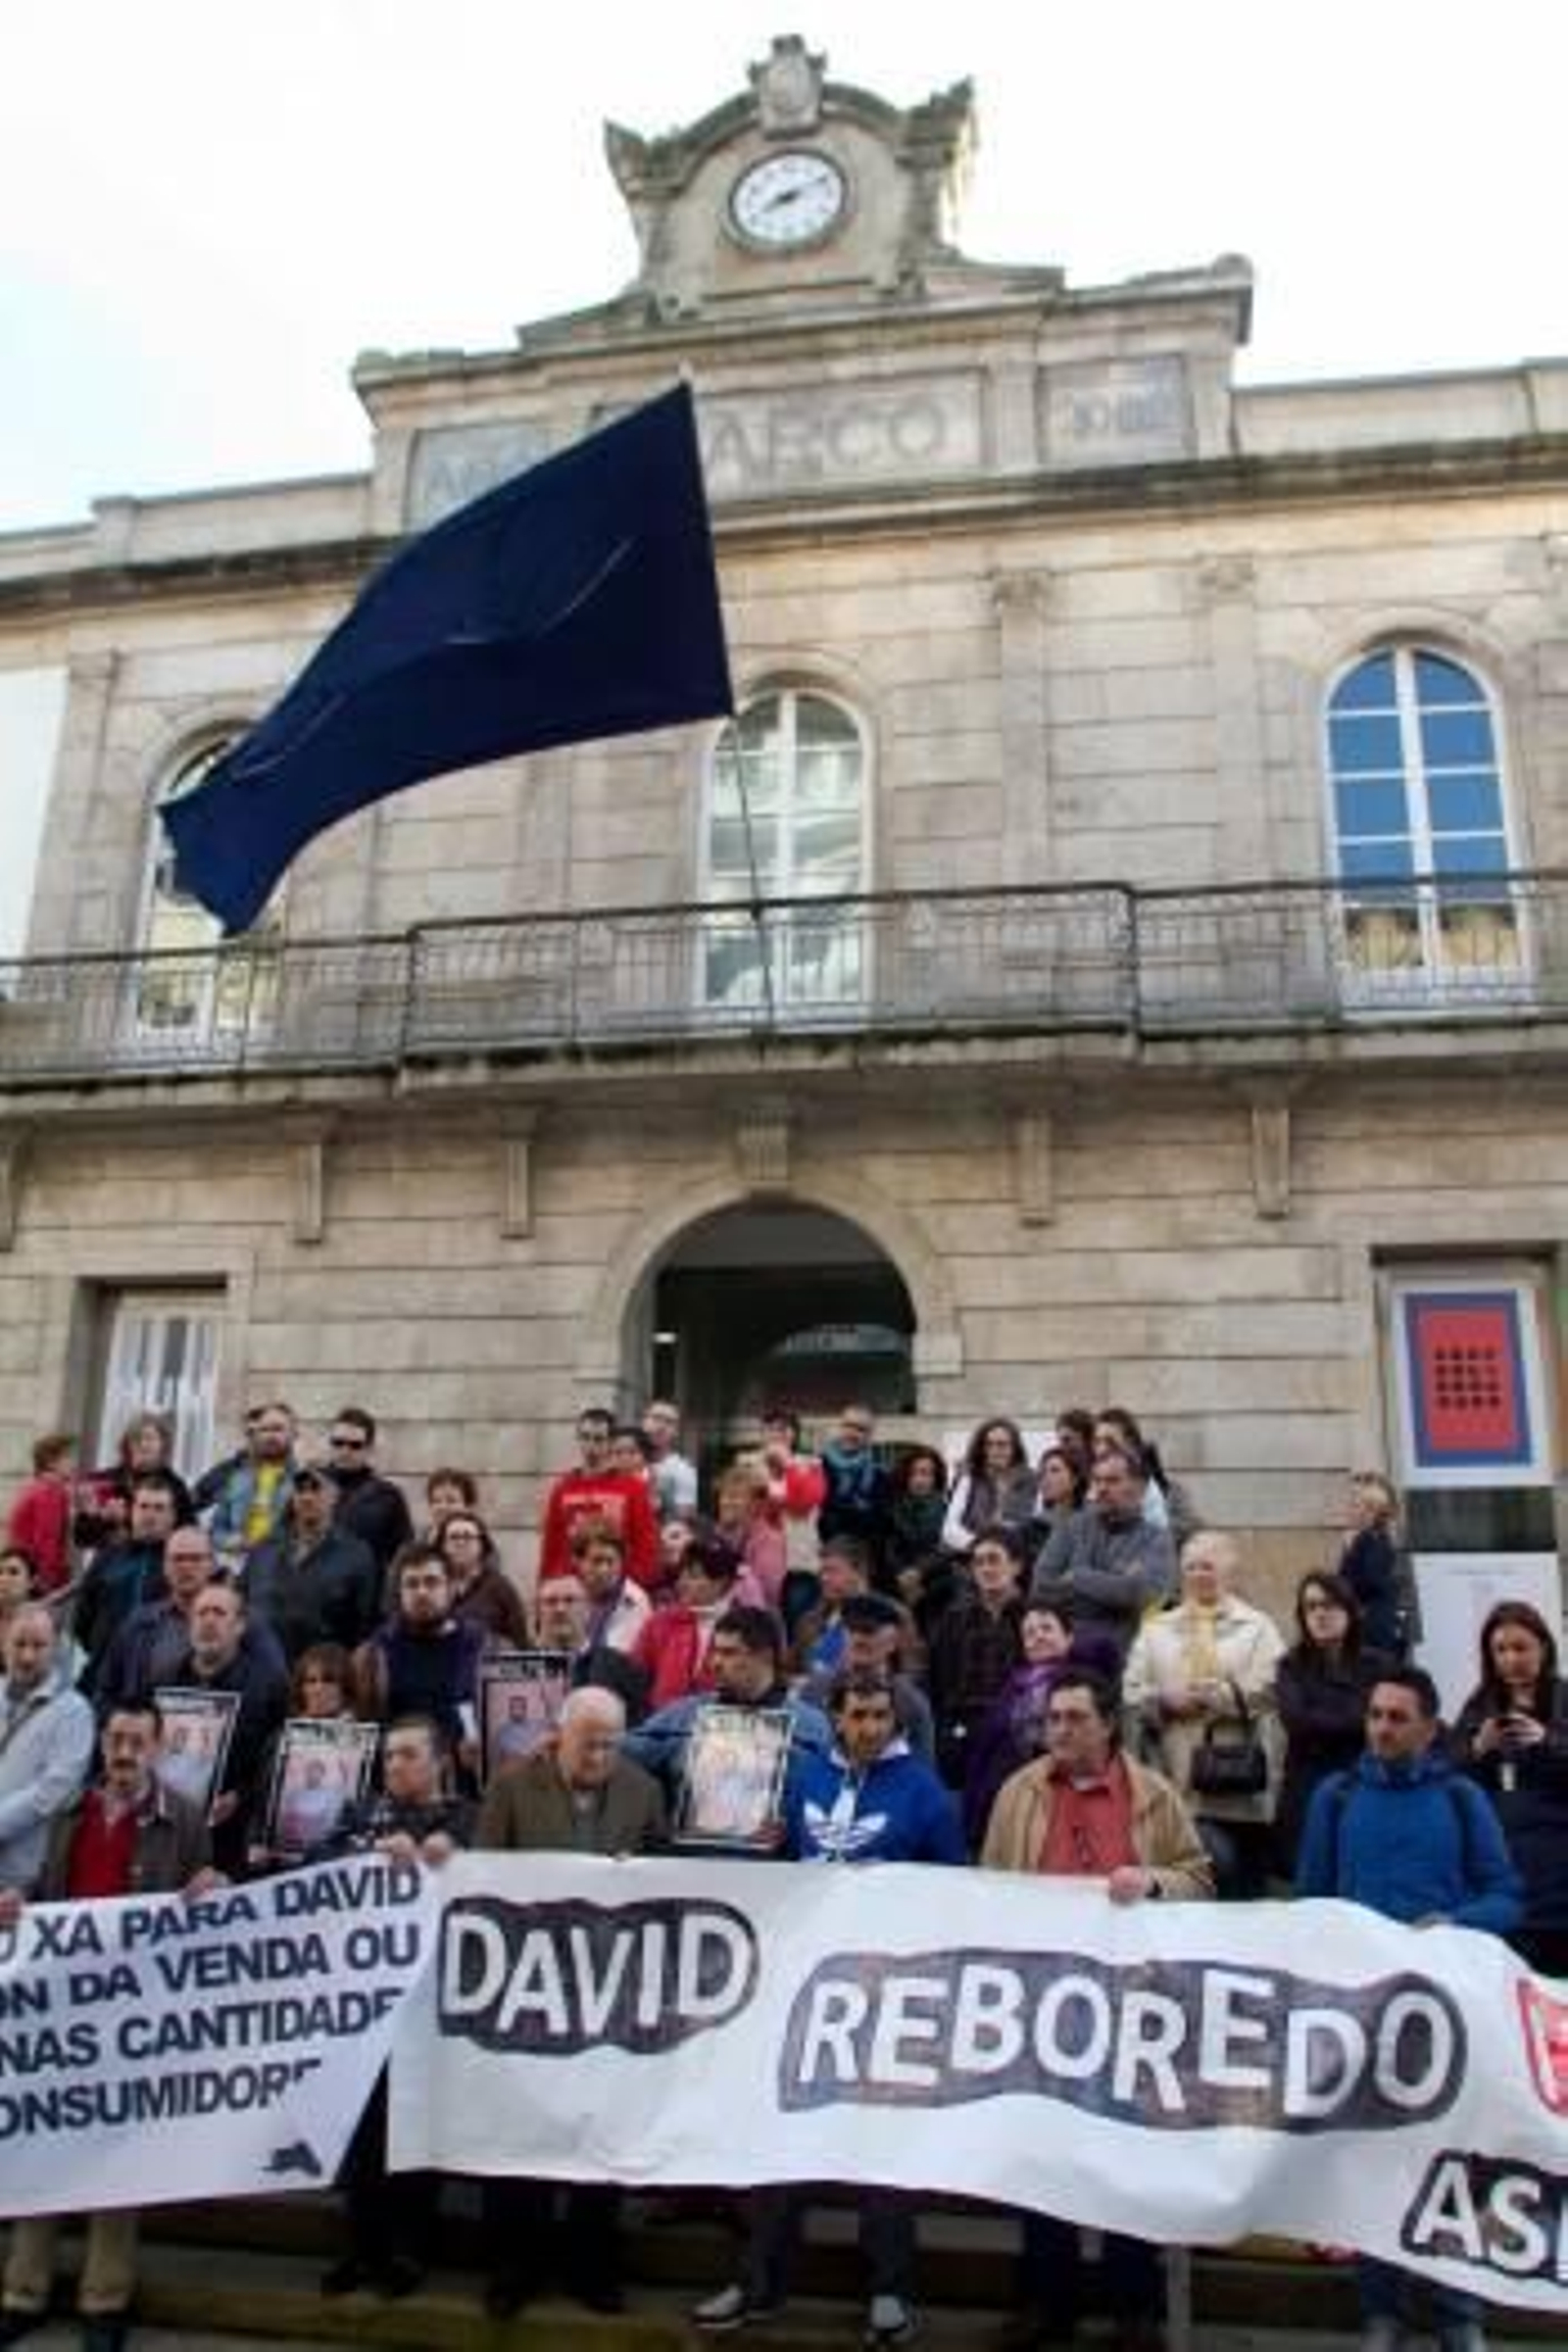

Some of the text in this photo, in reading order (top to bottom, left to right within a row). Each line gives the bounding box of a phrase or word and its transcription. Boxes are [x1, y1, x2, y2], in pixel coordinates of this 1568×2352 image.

[708, 402, 947, 478] ARCO
[32, 1914, 104, 1960] XA
[121, 1892, 257, 1950] PARA
[273, 1865, 420, 1917] DAVID
[70, 1964, 141, 2005] DA
[157, 1933, 330, 1992] VENDA
[346, 1924, 419, 1970] OU
[440, 1911, 755, 2036] DAVID
[798, 1963, 1454, 2117] REBOREDO
